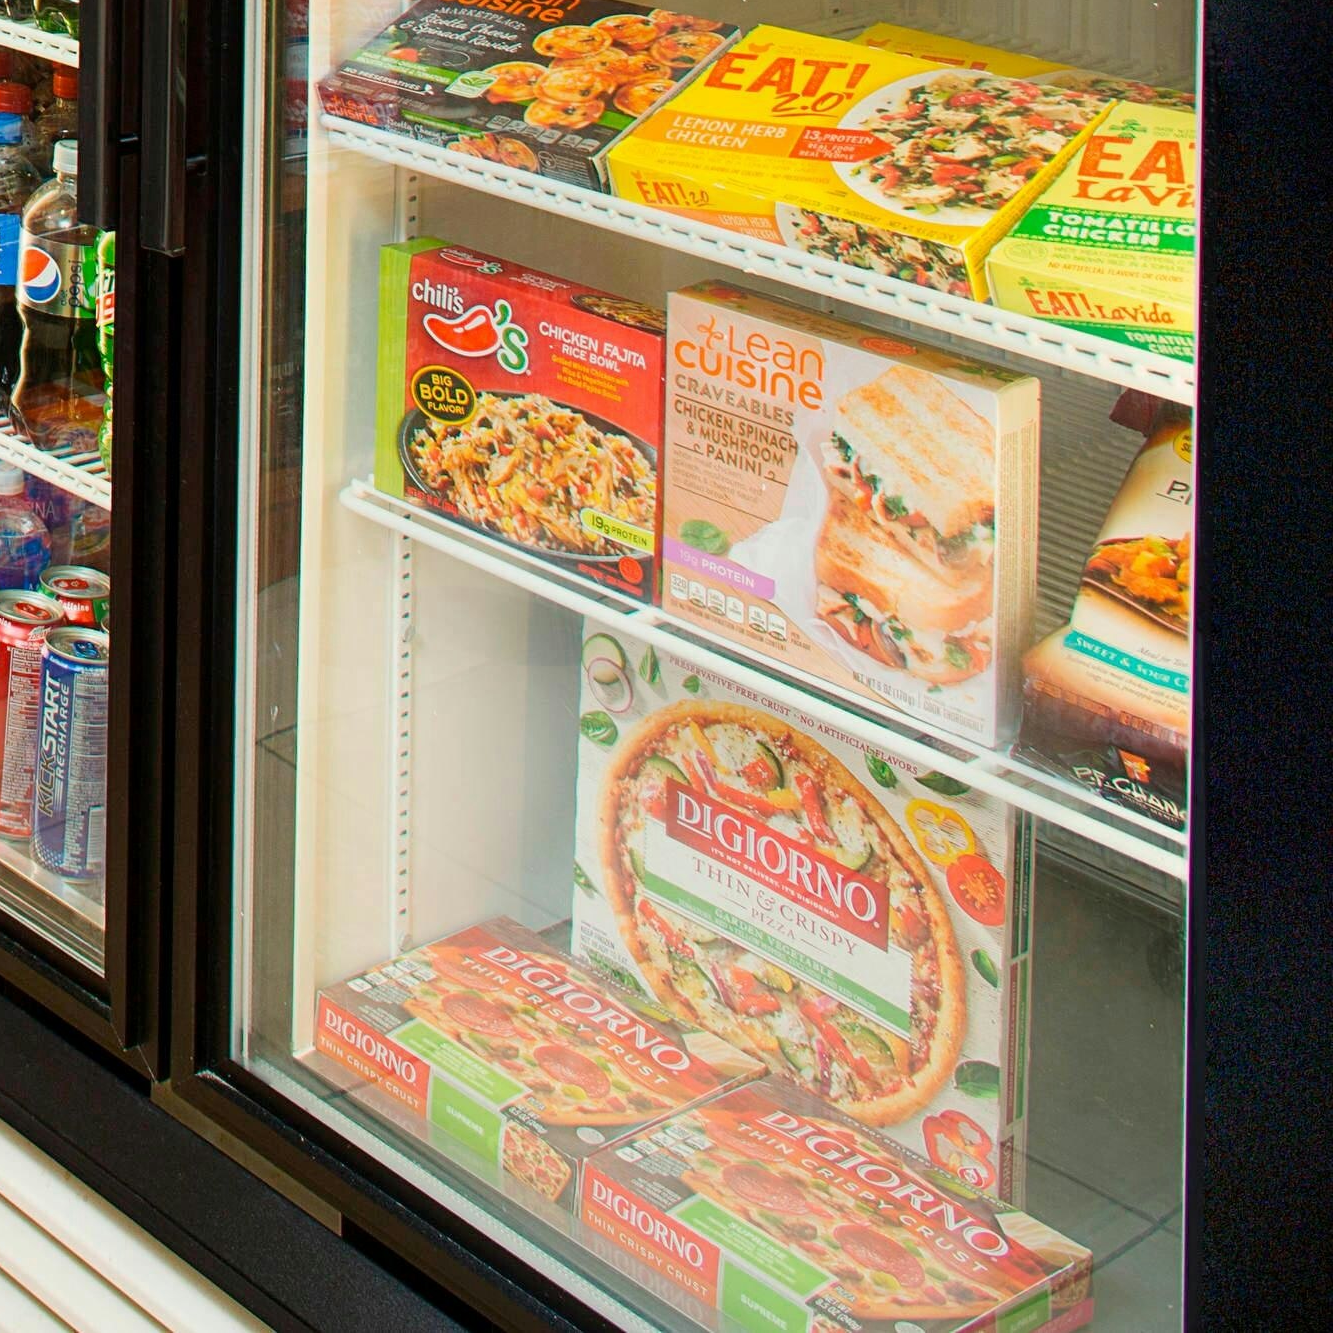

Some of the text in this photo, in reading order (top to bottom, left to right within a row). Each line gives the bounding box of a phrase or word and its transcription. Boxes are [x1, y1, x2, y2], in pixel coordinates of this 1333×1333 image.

[704, 50, 872, 100] EAT!
[673, 116, 789, 140] LEMON HERB
[1047, 211, 1194, 237] TOMATILLO
[412, 278, 464, 314] chili's
[603, 342, 647, 370] FAJITA
[420, 384, 469, 406] BOLD
[431, 373, 453, 389] BIG
[675, 373, 796, 428] CRAVEABLES
[699, 424, 785, 469] MUSHROOM
[705, 445, 764, 479] PANINI
[56, 682, 71, 782] RECHARGE
[676, 791, 878, 923] DIGIORNO
[693, 855, 749, 900] THIN
[779, 902, 859, 957] CRISPY
[751, 908, 796, 941] PIZZA
